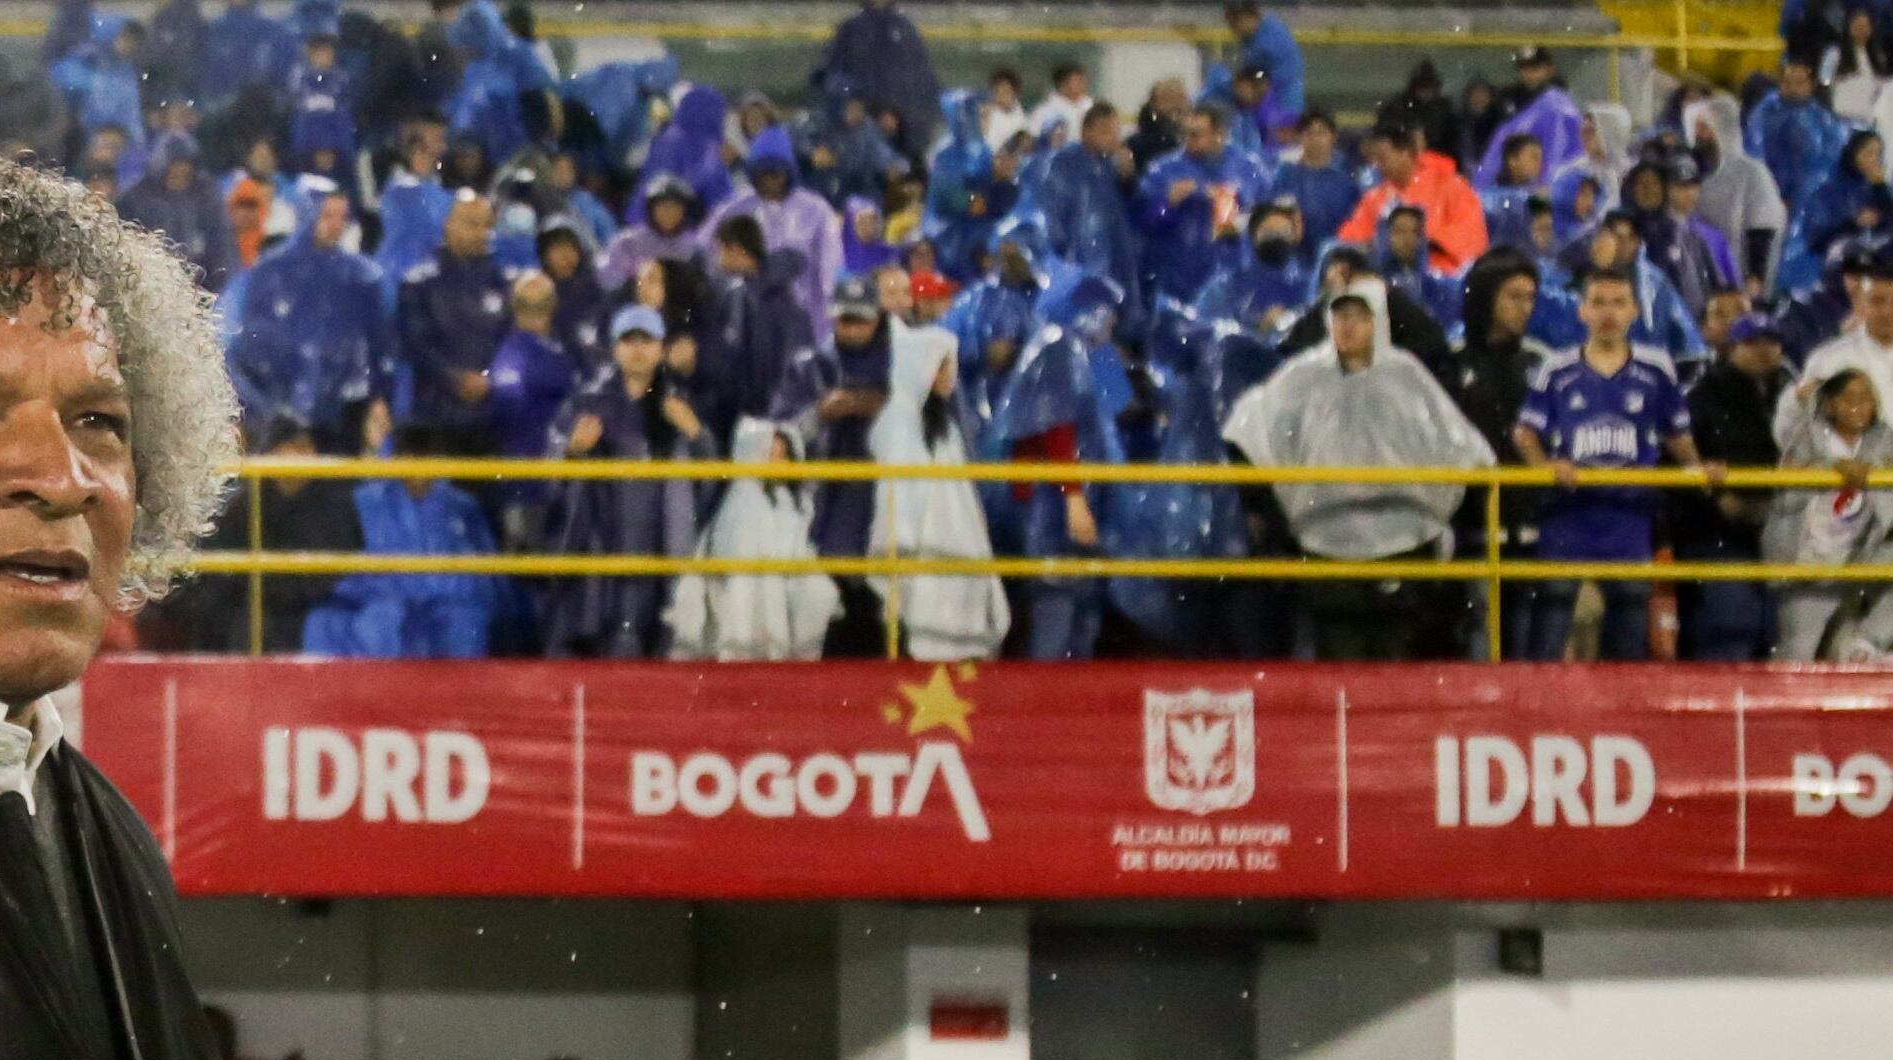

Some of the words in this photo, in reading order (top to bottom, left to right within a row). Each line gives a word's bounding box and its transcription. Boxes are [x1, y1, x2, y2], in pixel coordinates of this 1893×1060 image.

[262, 726, 491, 823] IDRD
[1435, 735, 1657, 828] IDRD
[1120, 851, 1148, 872] DE
[1219, 825, 1292, 846] MAYOR
